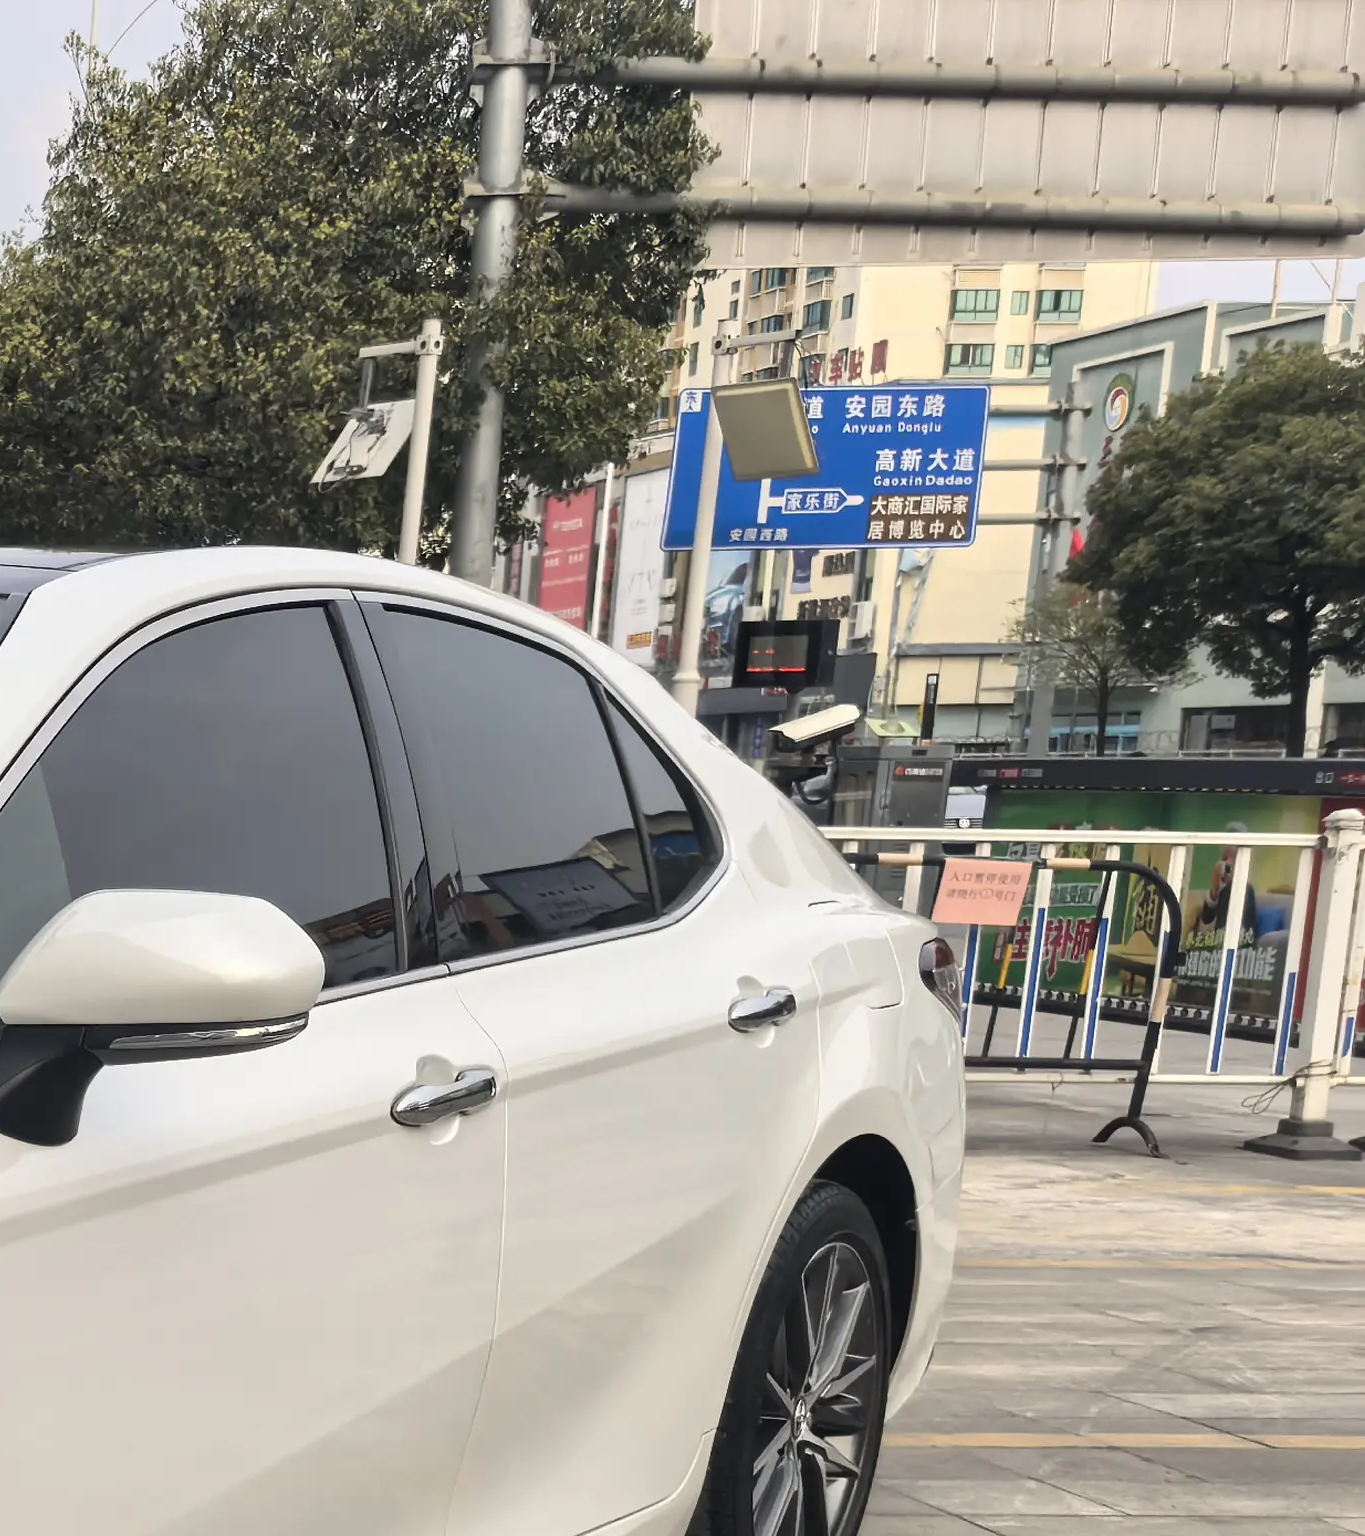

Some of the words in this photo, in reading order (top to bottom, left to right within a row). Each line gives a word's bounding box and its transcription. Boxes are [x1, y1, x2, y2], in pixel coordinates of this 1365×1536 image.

[844, 394, 946, 419] 安园东路
[842, 422, 891, 435] Anyuan
[898, 422, 942, 435] Donglu
[875, 448, 975, 473] 高新大道
[873, 475, 922, 488] Gaoxin
[926, 474, 973, 487] Dadao
[786, 492, 839, 512] 家乐街
[871, 495, 969, 517] 大商汇国际家
[867, 520, 967, 541] 居博览中心
